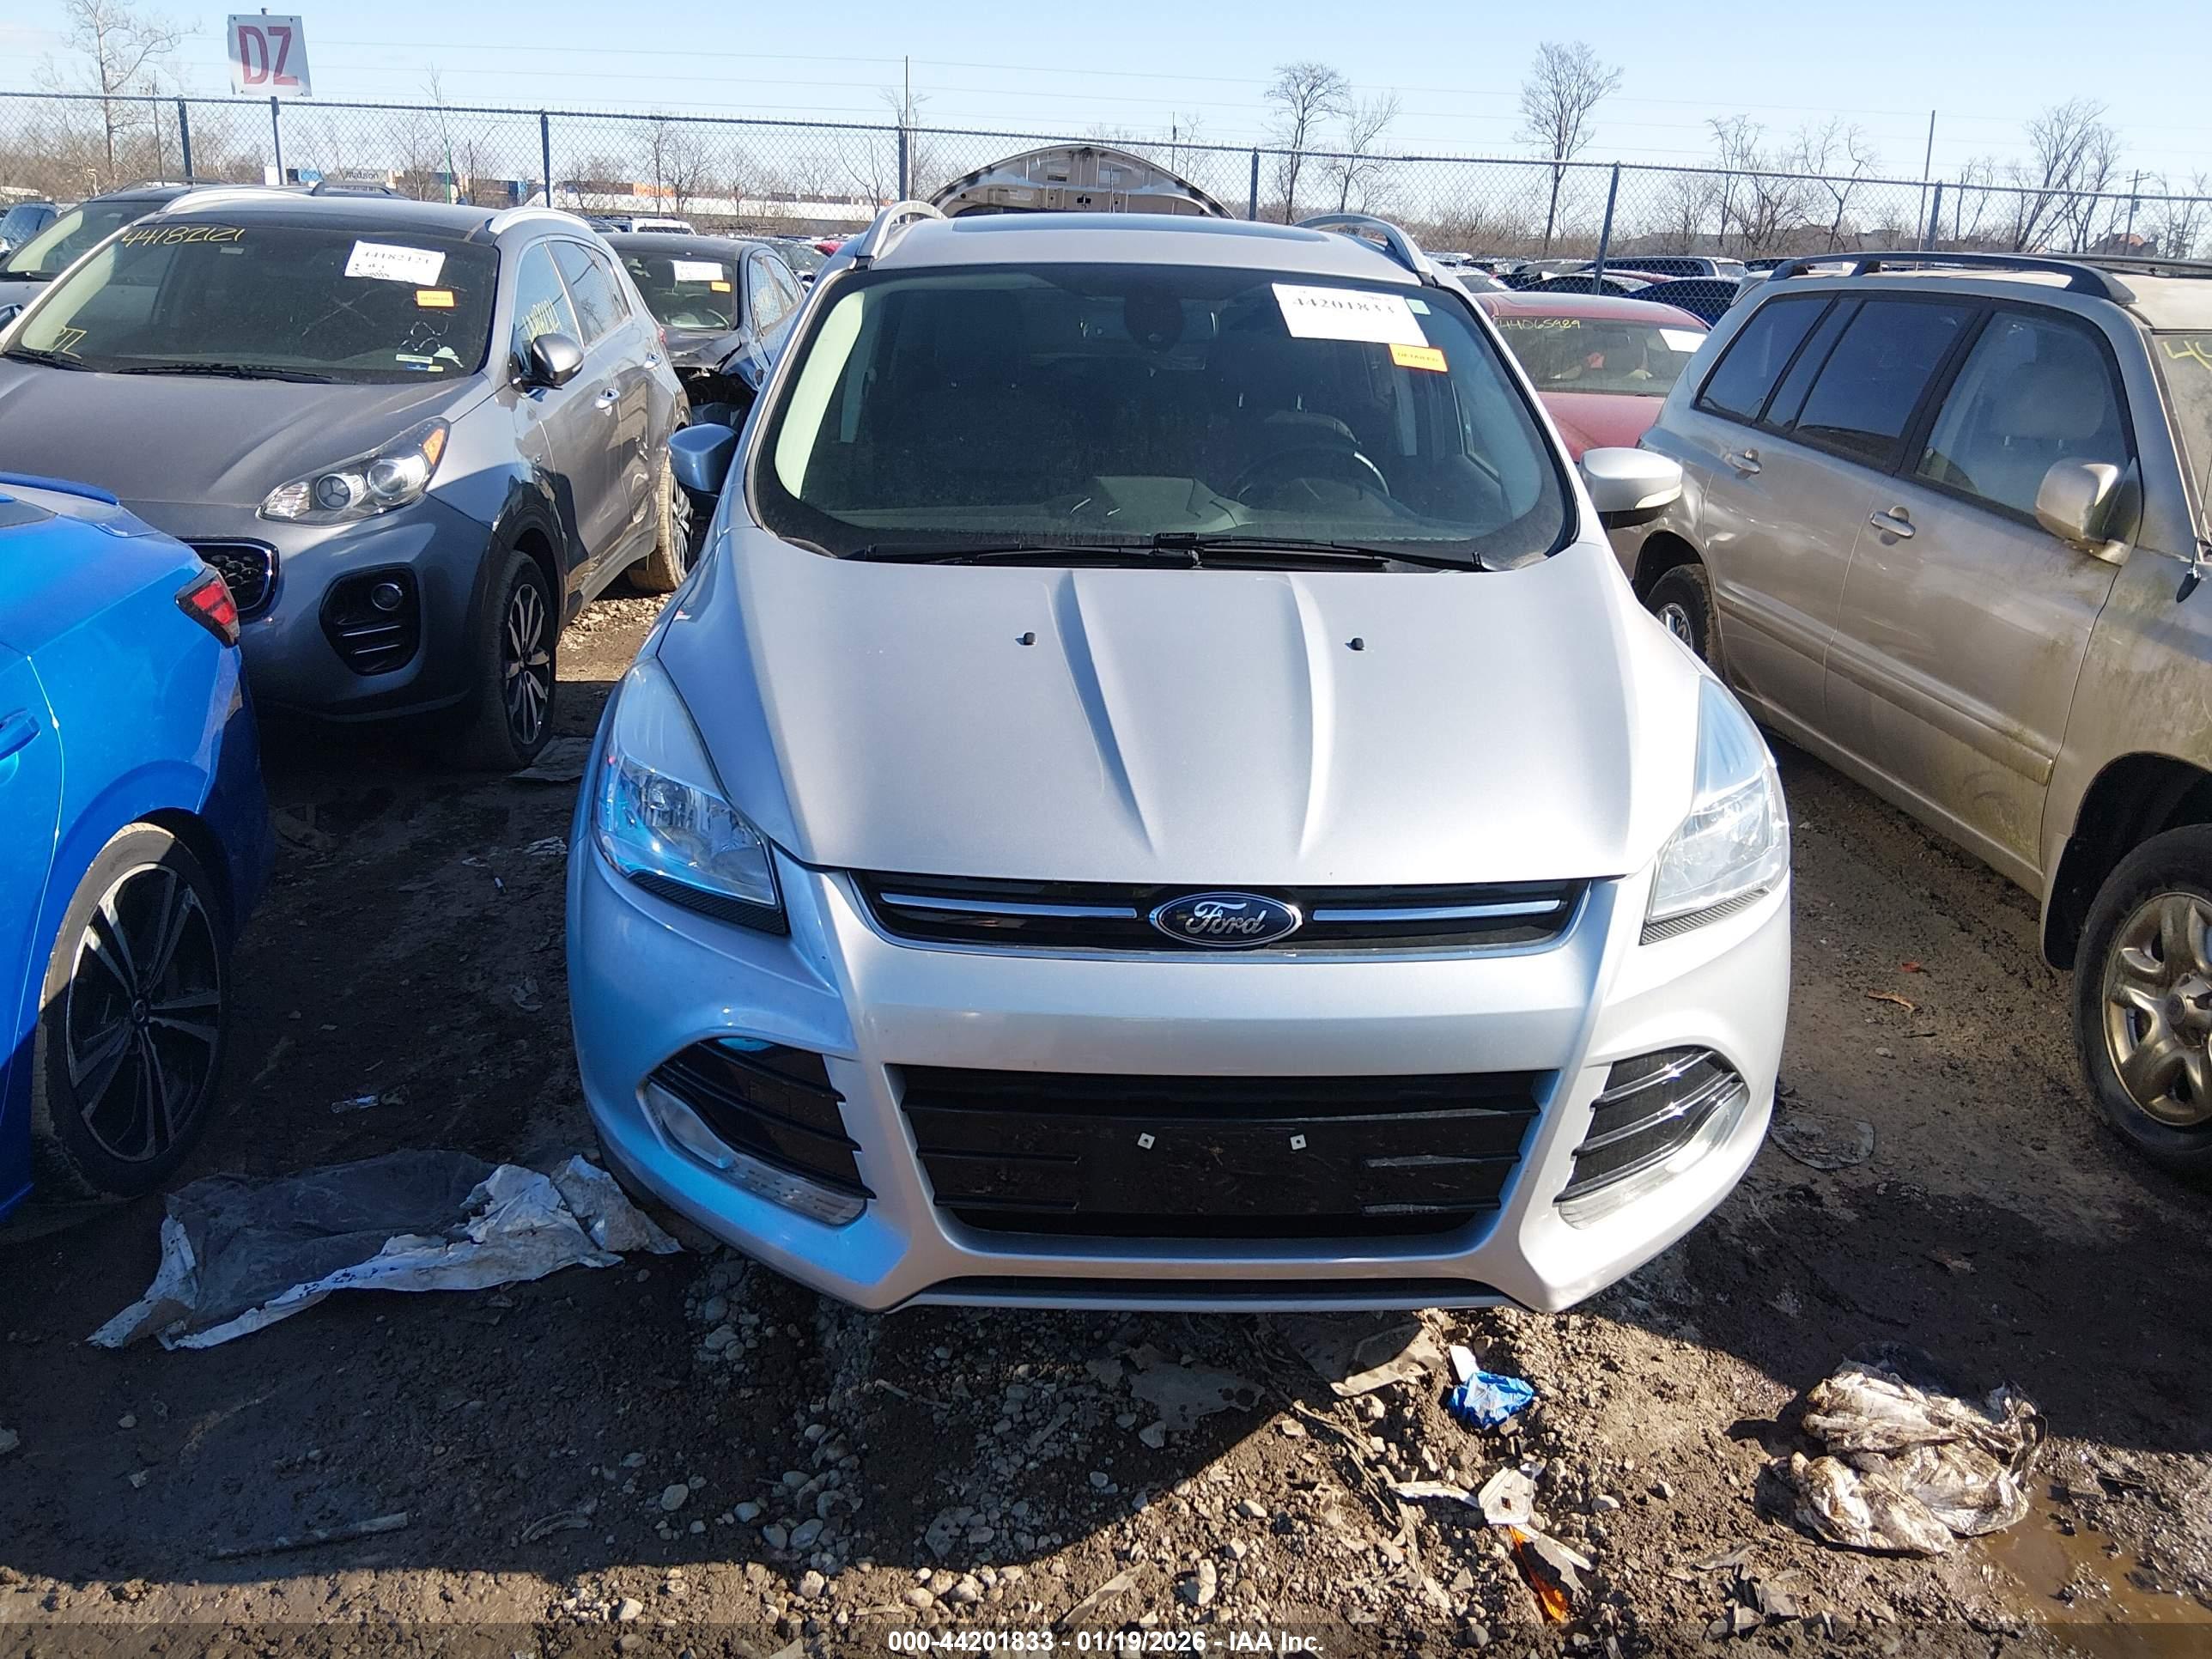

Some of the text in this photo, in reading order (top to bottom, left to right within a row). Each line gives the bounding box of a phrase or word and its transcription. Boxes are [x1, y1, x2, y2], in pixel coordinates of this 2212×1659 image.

[238, 26, 298, 85] DZ
[121, 226, 246, 248] 44182121
[1185, 902, 1267, 934] Ford
